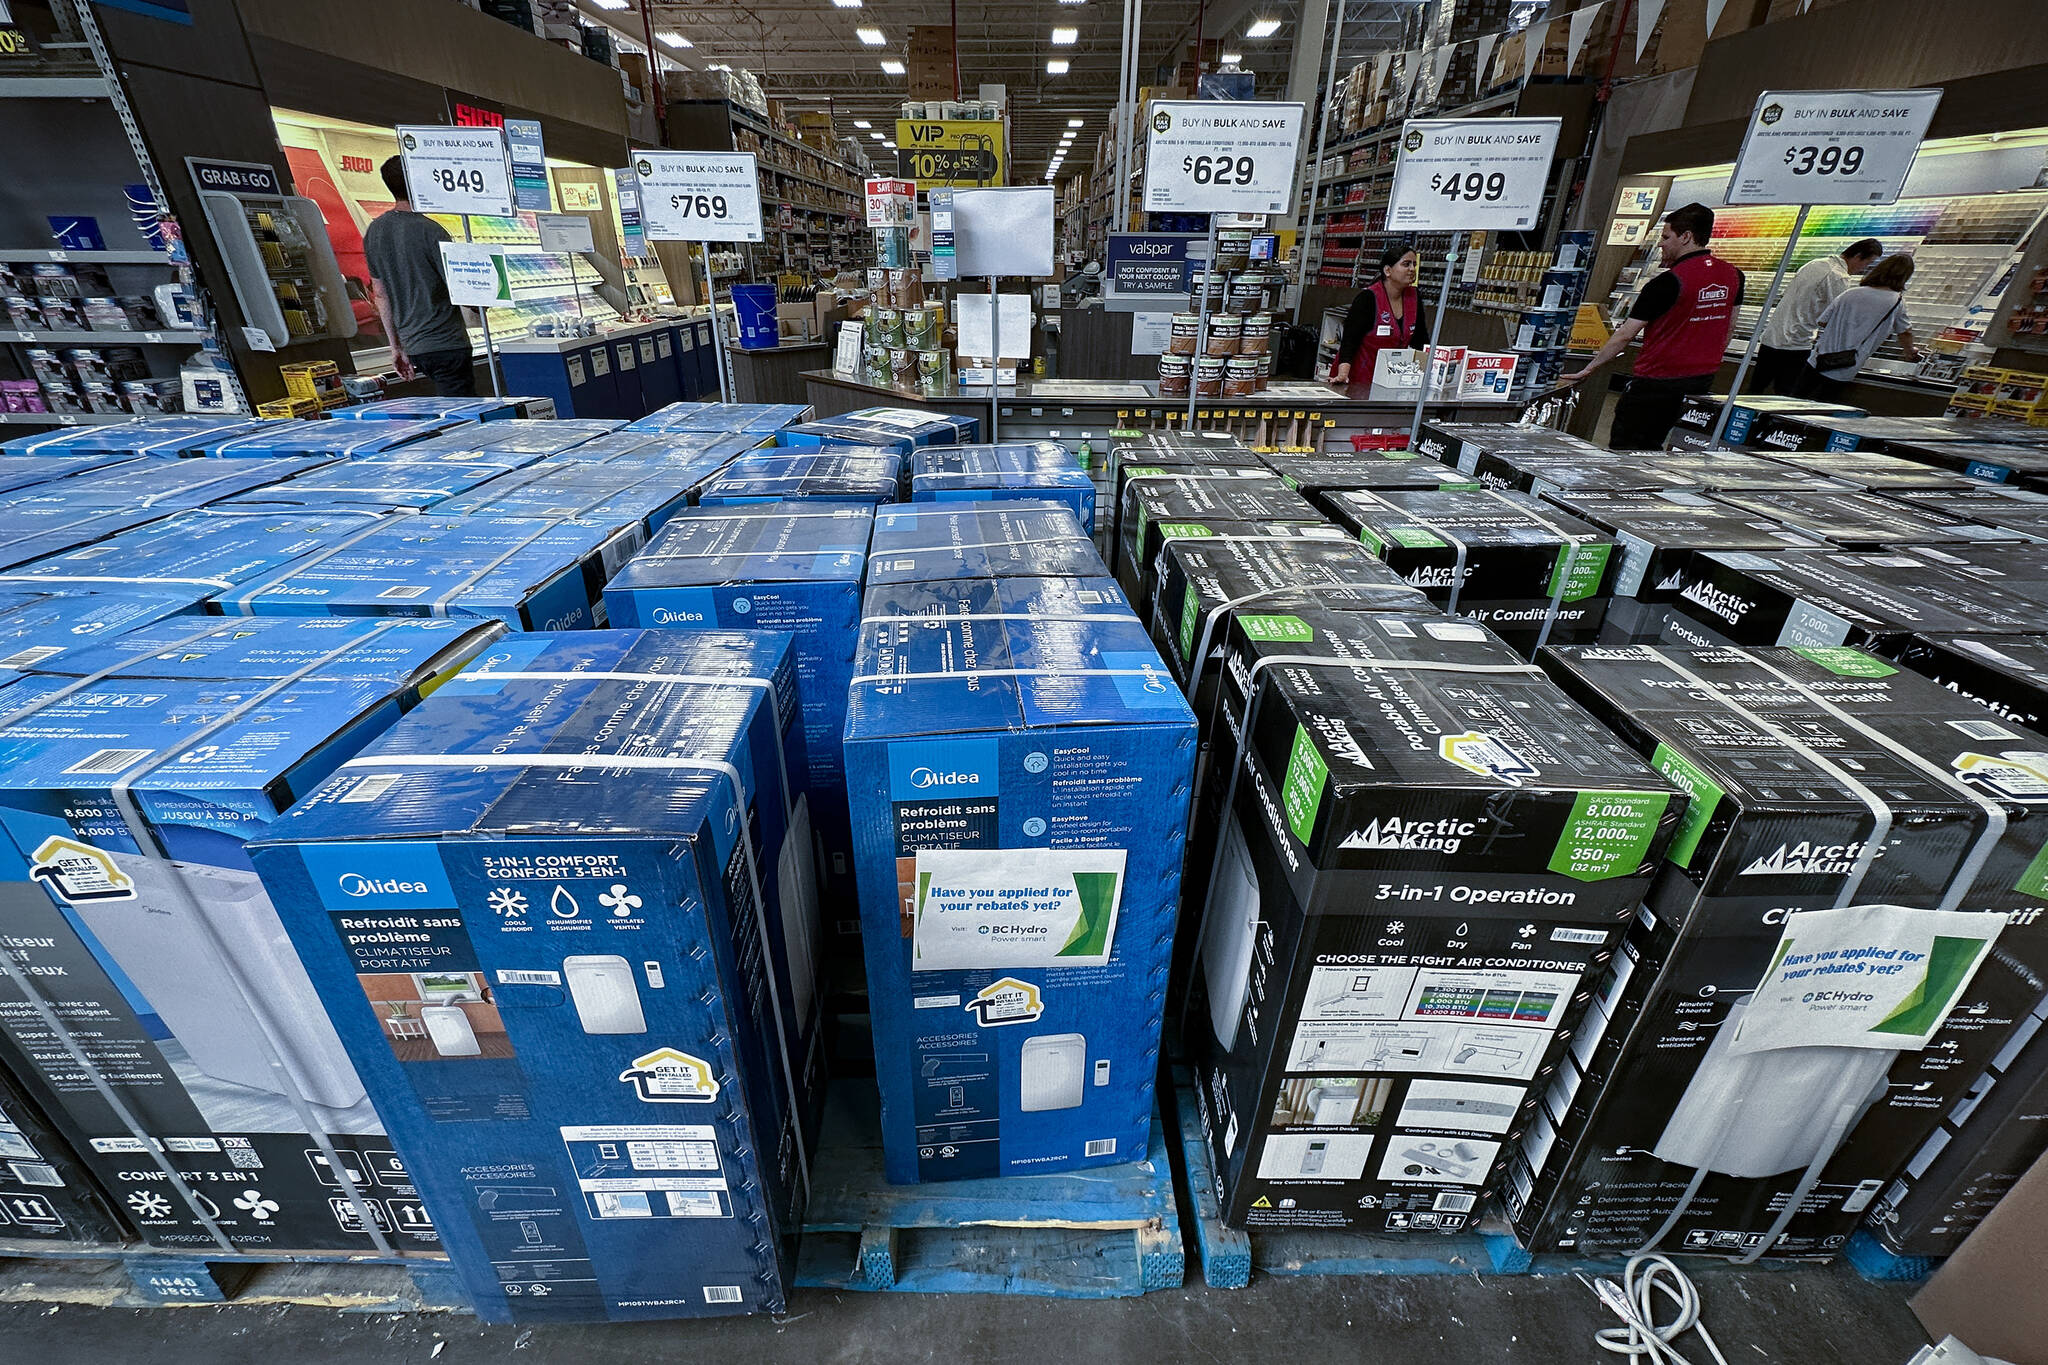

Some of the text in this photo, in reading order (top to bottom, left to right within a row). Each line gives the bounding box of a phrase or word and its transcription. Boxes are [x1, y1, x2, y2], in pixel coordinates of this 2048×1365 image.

[1794, 109, 1909, 118] BUY IN BULK AND SAVE
[1182, 118, 1286, 128] BUY IN BULK AND SAVE
[910, 125, 944, 142] VIP
[477, 140, 494, 148] SAVE
[1434, 135, 1541, 145] BUY IN BULK AND SAVE
[909, 154, 949, 177] 10%
[1784, 146, 1865, 175] $399
[1183, 155, 1254, 185] $629
[201, 169, 240, 185] GRAB
[249, 173, 270, 187] GO
[433, 169, 485, 193] $849
[1431, 172, 1505, 202] $499
[671, 195, 727, 219] $769
[1129, 241, 1173, 257] valspar
[1477, 359, 1501, 367] SAVE
[1702, 583, 1749, 614] Arctic
[652, 608, 703, 624] Midea
[1709, 599, 1740, 625] King
[1054, 747, 1089, 755] EasyCool
[911, 767, 979, 788] Midea
[64, 809, 102, 818] 8,600
[161, 811, 259, 822] JUSQU'À 350 pi²
[900, 805, 996, 817] Refroidit sans
[901, 818, 967, 831] problème
[72, 827, 115, 836] 14,000
[902, 831, 980, 842] CLIMATISEUR
[1397, 833, 1462, 854] King
[1570, 849, 1603, 860] 350
[58, 858, 92, 867] GET IT
[483, 855, 619, 868] 3-IN-1 COMFORT
[1570, 863, 1589, 872] (32
[64, 865, 98, 873] INSTALLED
[487, 867, 627, 879] CONFORT 3-EN-1
[339, 873, 428, 897] Midea
[932, 887, 1073, 899] Have you applied for
[1375, 884, 1576, 906] 3-in-1 Operation
[940, 902, 973, 913] your
[1034, 900, 1061, 912] yet?
[341, 917, 461, 929] Refroidit sans
[992, 925, 1048, 935] BC Hydro
[347, 932, 431, 945] problème
[1378, 939, 1532, 951] Cool Dry Fan
[354, 947, 452, 957] CLIMATISEUR
[1782, 948, 1925, 968] Have you applied for
[360, 957, 431, 969] PORTATIF
[1316, 955, 1377, 964] CHOOSE
[1380, 955, 1408, 964] THE
[1457, 958, 1482, 967] AIR
[1486, 959, 1586, 971] CONDITIONER
[1833, 991, 1874, 1003] Hydro
[1809, 1004, 1868, 1012] Power smart
[916, 1032, 978, 1043] ACCESSORIES
[918, 1039, 977, 1049] ACCESSOIRES
[460, 1164, 535, 1173] ACCESSORIES
[118, 1172, 259, 1181] CONFRT 3 EN 1
[465, 1171, 536, 1181] ACCESSOIRES
